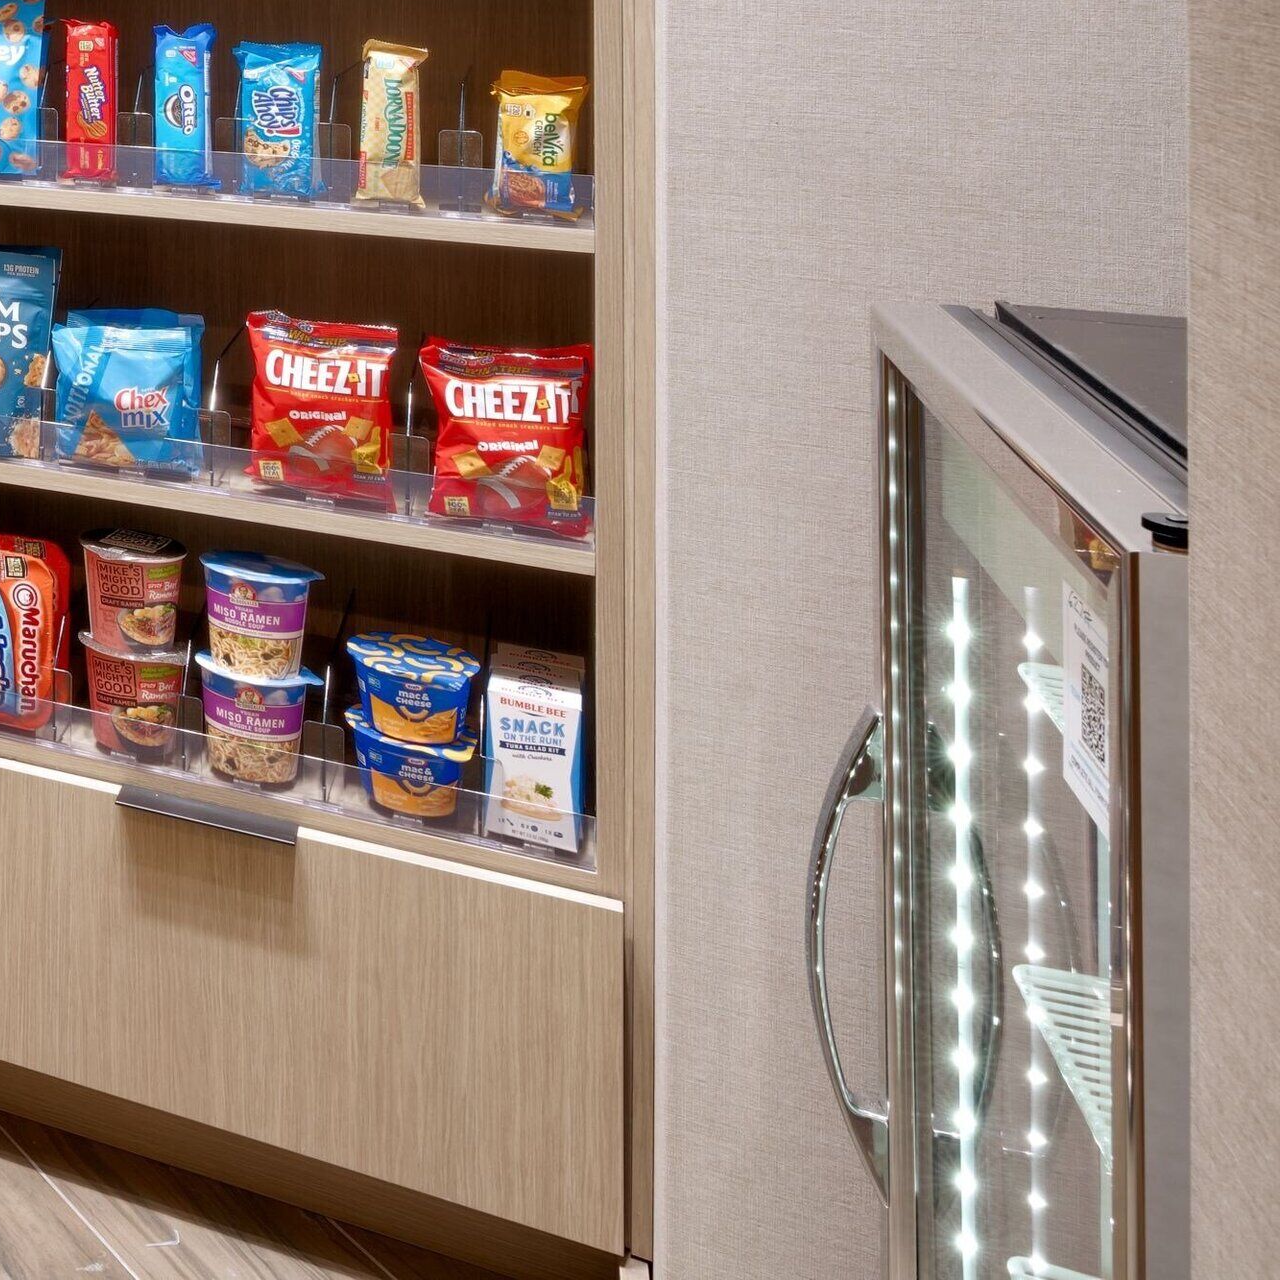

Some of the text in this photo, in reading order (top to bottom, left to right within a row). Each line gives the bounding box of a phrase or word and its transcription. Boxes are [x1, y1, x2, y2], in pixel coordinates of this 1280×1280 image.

[177, 85, 198, 136] OREO
[266, 86, 299, 132] Chips
[534, 120, 543, 157] CRUNCHY
[114, 387, 169, 412] Chex
[121, 410, 170, 428] mix
[98, 563, 142, 578] MIKE'S
[100, 574, 141, 588] MIGHTY
[101, 582, 141, 597] GOOD
[121, 599, 144, 609] RAMEN
[213, 602, 280, 626] MISO RAMEN
[17, 607, 42, 713] Maruchan
[93, 659, 135, 675] MIKE'S
[95, 671, 134, 685] MIGHTY
[96, 680, 133, 695] GOOD
[499, 696, 568, 720] BUMBLE BEE
[216, 706, 285, 729] MISO RAMEN
[500, 716, 566, 738] SNACK
[503, 731, 563, 748] ON THE RUN!
[504, 742, 560, 756] TUNA SALAD KIT
